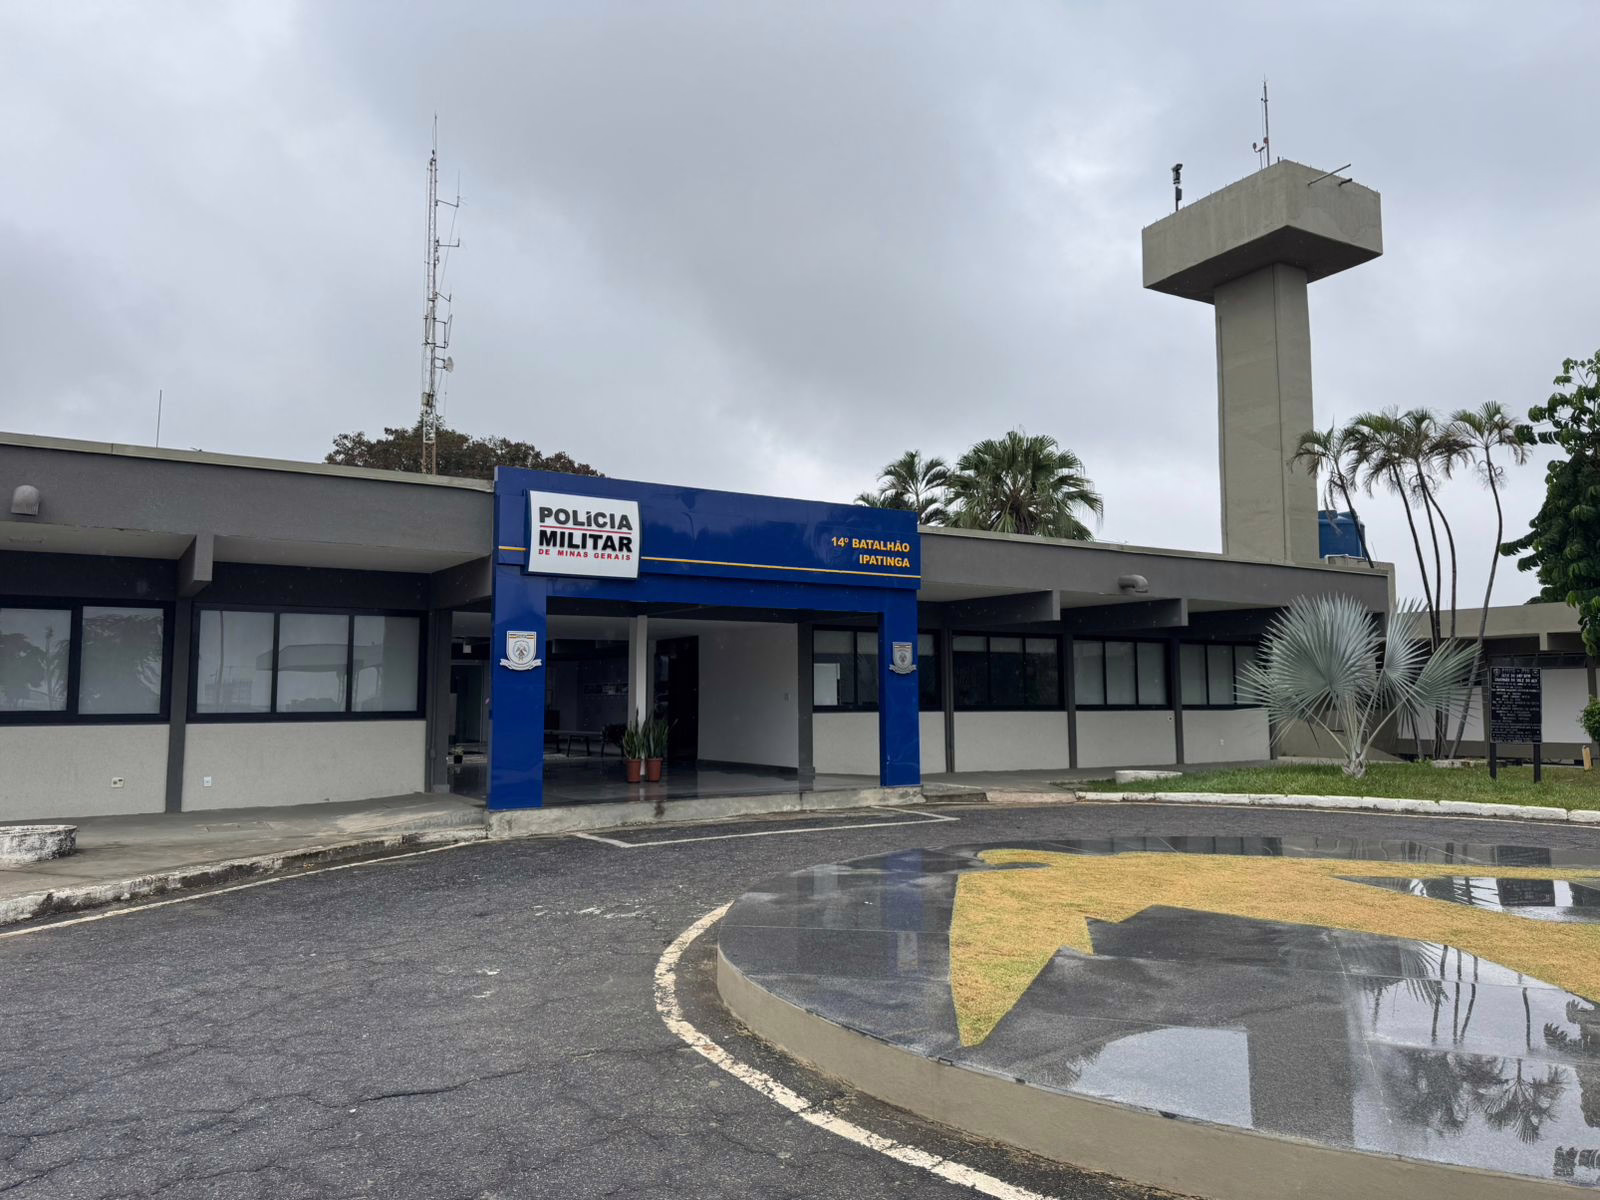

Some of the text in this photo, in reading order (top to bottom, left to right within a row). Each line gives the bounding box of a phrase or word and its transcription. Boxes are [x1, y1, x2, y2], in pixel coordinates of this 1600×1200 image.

[539, 530, 633, 552] MILITAR
[852, 538, 910, 552] BATALHÃO
[557, 550, 588, 558] MINAS
[859, 554, 910, 567] IPATINGA
